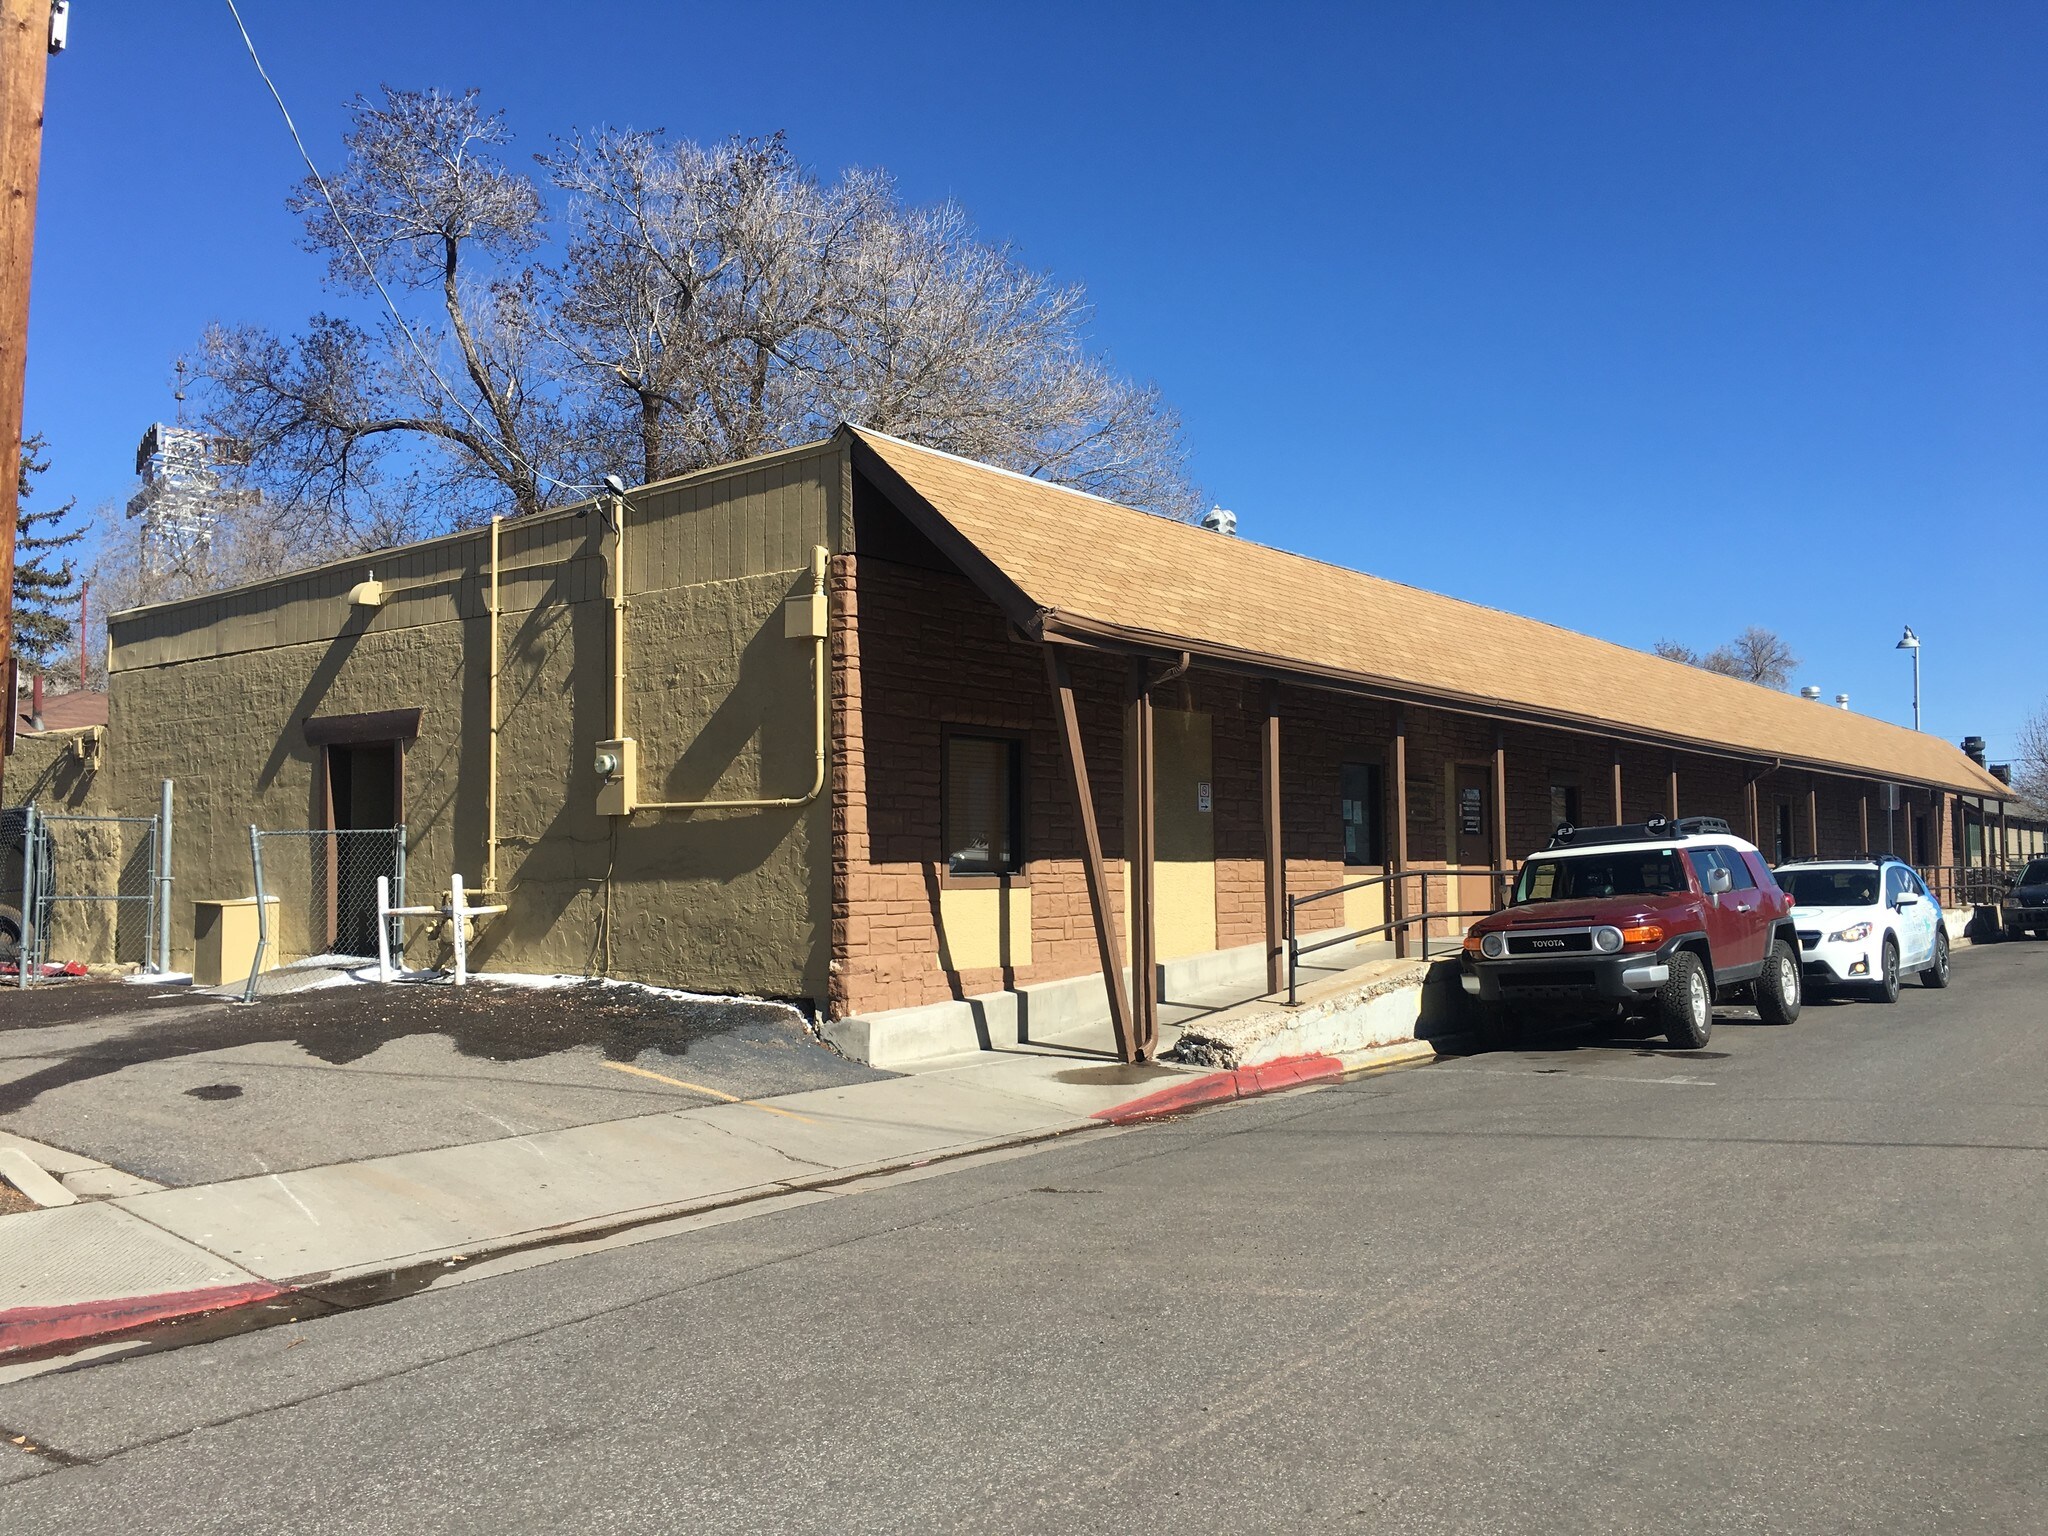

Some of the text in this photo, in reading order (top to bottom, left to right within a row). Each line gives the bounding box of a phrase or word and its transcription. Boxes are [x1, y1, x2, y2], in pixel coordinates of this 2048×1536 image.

[1648, 818, 1666, 827] FJ
[1557, 827, 1573, 835] FJ
[1532, 940, 1565, 948] TOYOTA
